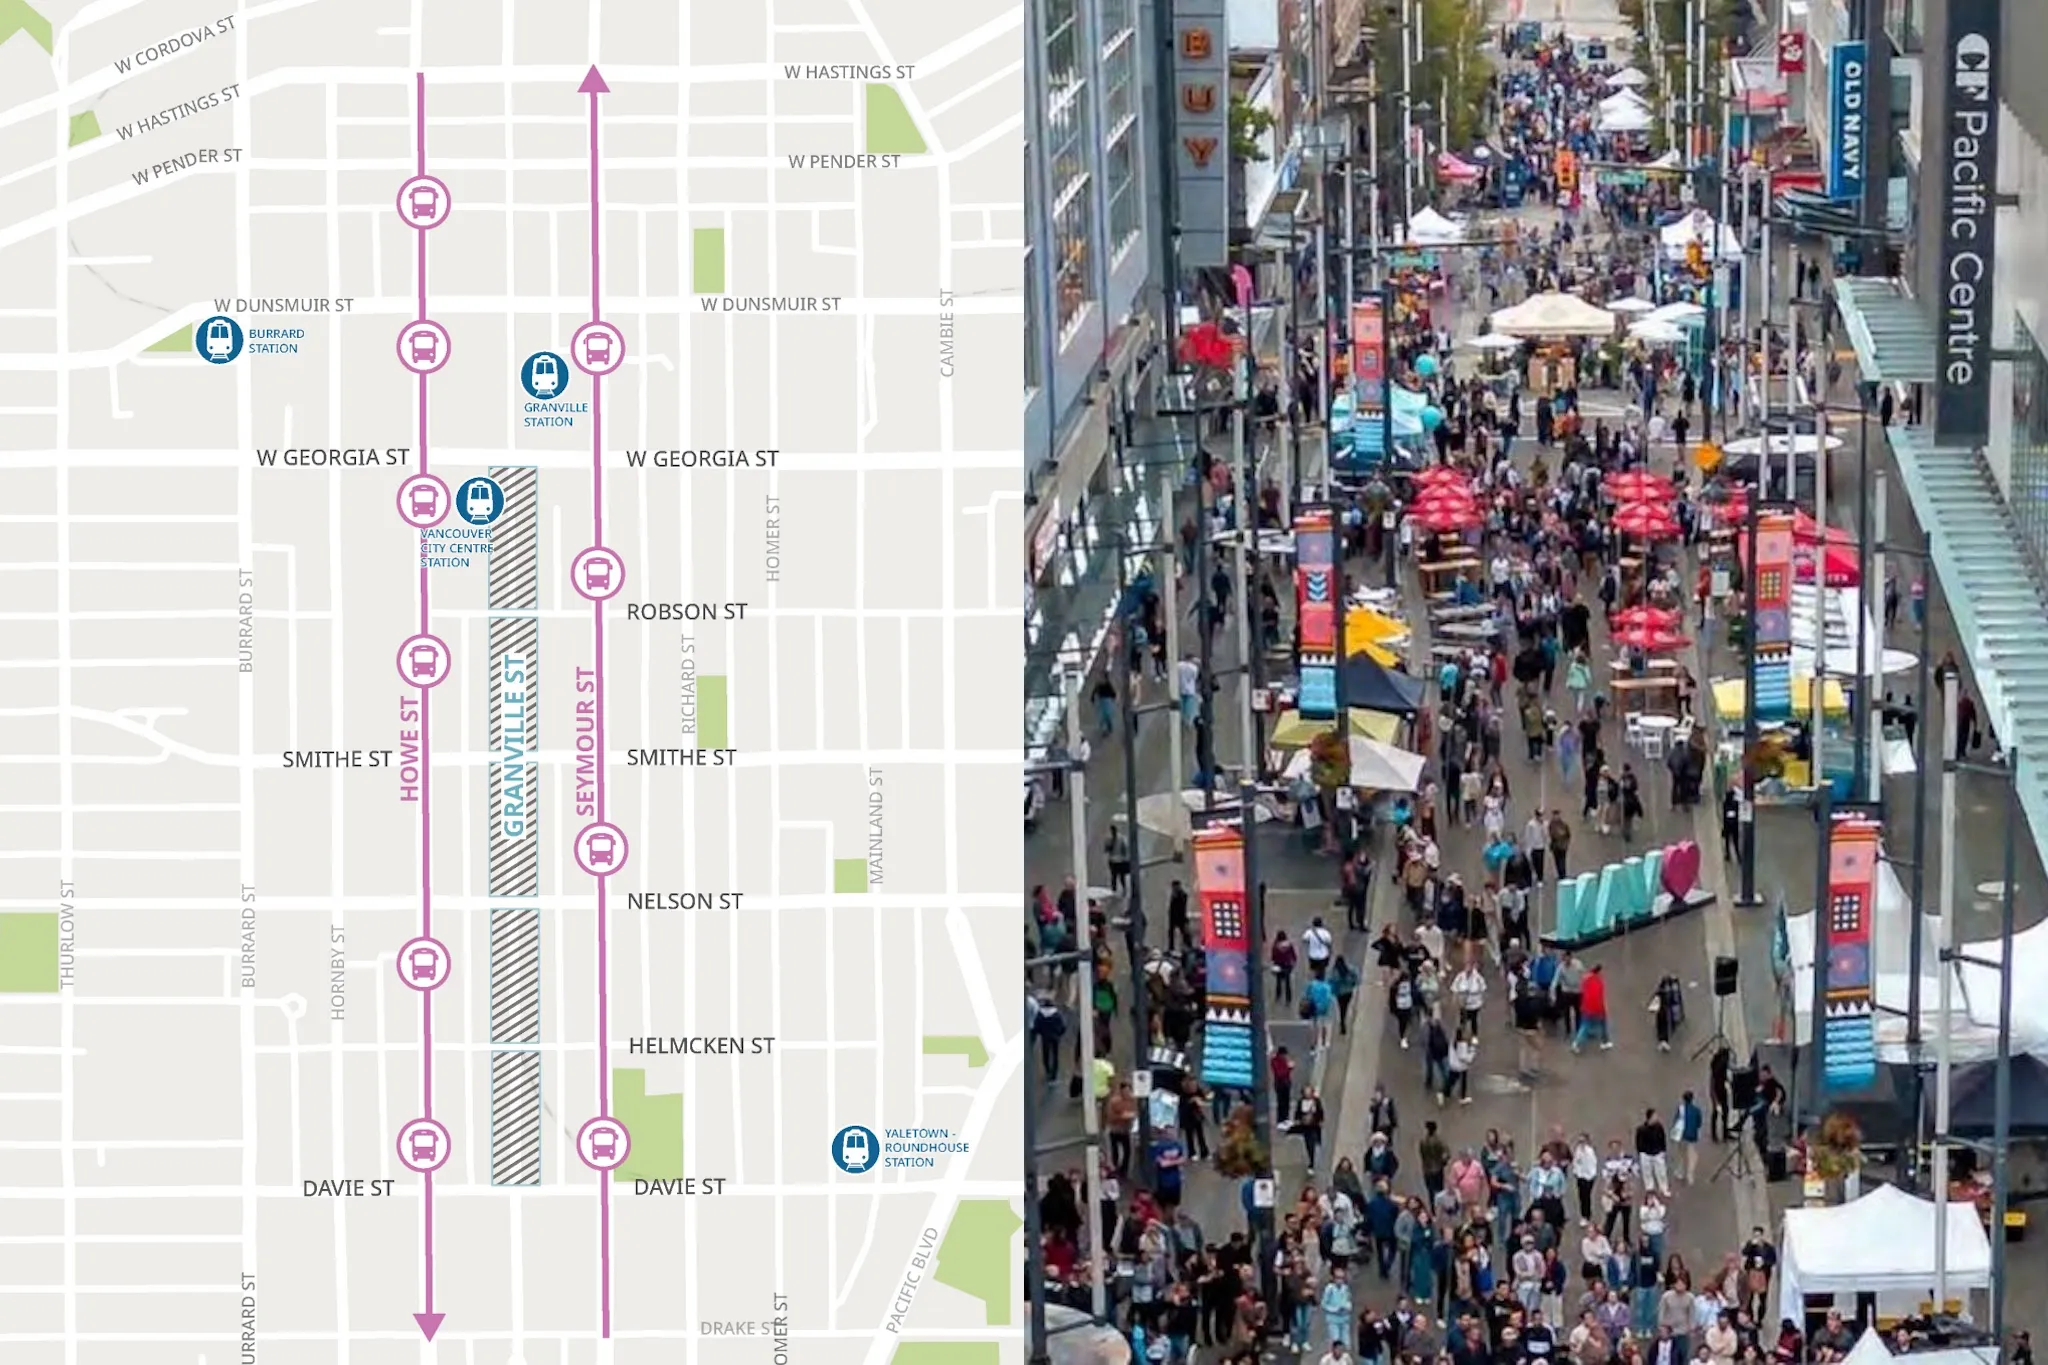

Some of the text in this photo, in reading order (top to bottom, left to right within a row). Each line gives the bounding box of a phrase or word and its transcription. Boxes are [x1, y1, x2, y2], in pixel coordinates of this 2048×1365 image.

[114, 15, 234, 73] W CORDOVA ST
[785, 65, 915, 79] W HASTINGS ST
[1180, 27, 1218, 168] BUY
[116, 84, 239, 140] W HASTINGS ST
[1842, 61, 1862, 180] OLD NAVY
[132, 149, 242, 185] W PENDER ST
[789, 155, 901, 168] W PENDER ST
[1951, 110, 1989, 239] Pacific
[214, 299, 354, 312] W DUNSMUIR ST
[701, 297, 841, 311] W DUNSMUIR ST
[1946, 254, 1985, 385] Centre
[249, 329, 304, 339] BURRARD
[940, 289, 954, 377] CAMBIE ST
[249, 344, 297, 353] STATION
[525, 403, 587, 412] GRANVILLE
[524, 417, 573, 426] STATION
[257, 449, 409, 466] W GEORGIA ST
[627, 450, 779, 467] W GEORGIA ST
[421, 529, 491, 538] VANCOUVER
[766, 495, 779, 581] HOMER ST
[421, 544, 491, 553] CITY CENTRE
[421, 558, 469, 567] STATION
[628, 603, 748, 620] ROBSON ST
[239, 569, 252, 672] BURRARD ST
[682, 634, 695, 733] RICHARD ST
[400, 696, 418, 801] HOWE ST
[504, 656, 524, 836] GRANVILLE ST
[576, 667, 594, 816] SEYMOUR ST
[283, 751, 392, 767] SMITHE ST
[628, 749, 737, 765] SMITHE ST
[869, 767, 883, 883] MAINLAND ST
[629, 893, 743, 909] NELSON ST
[61, 880, 74, 989] THURLOW ST
[242, 884, 255, 987] BURRARD ST
[331, 925, 344, 1019] HORNBY ST
[630, 1038, 775, 1053] HELMCKEN ST
[886, 1129, 948, 1138] YALETOWN
[886, 1143, 968, 1152] ROUNDHOUSE
[885, 1157, 933, 1166] STATION
[304, 1180, 394, 1196] DAVIE ST
[635, 1178, 726, 1195] DAVIE ST
[886, 1228, 937, 1334] PACIFIC BLVD
[241, 1272, 255, 1365] URRARD ST
[701, 1322, 755, 1335] DRAKE
[773, 1292, 787, 1365] OMER ST
